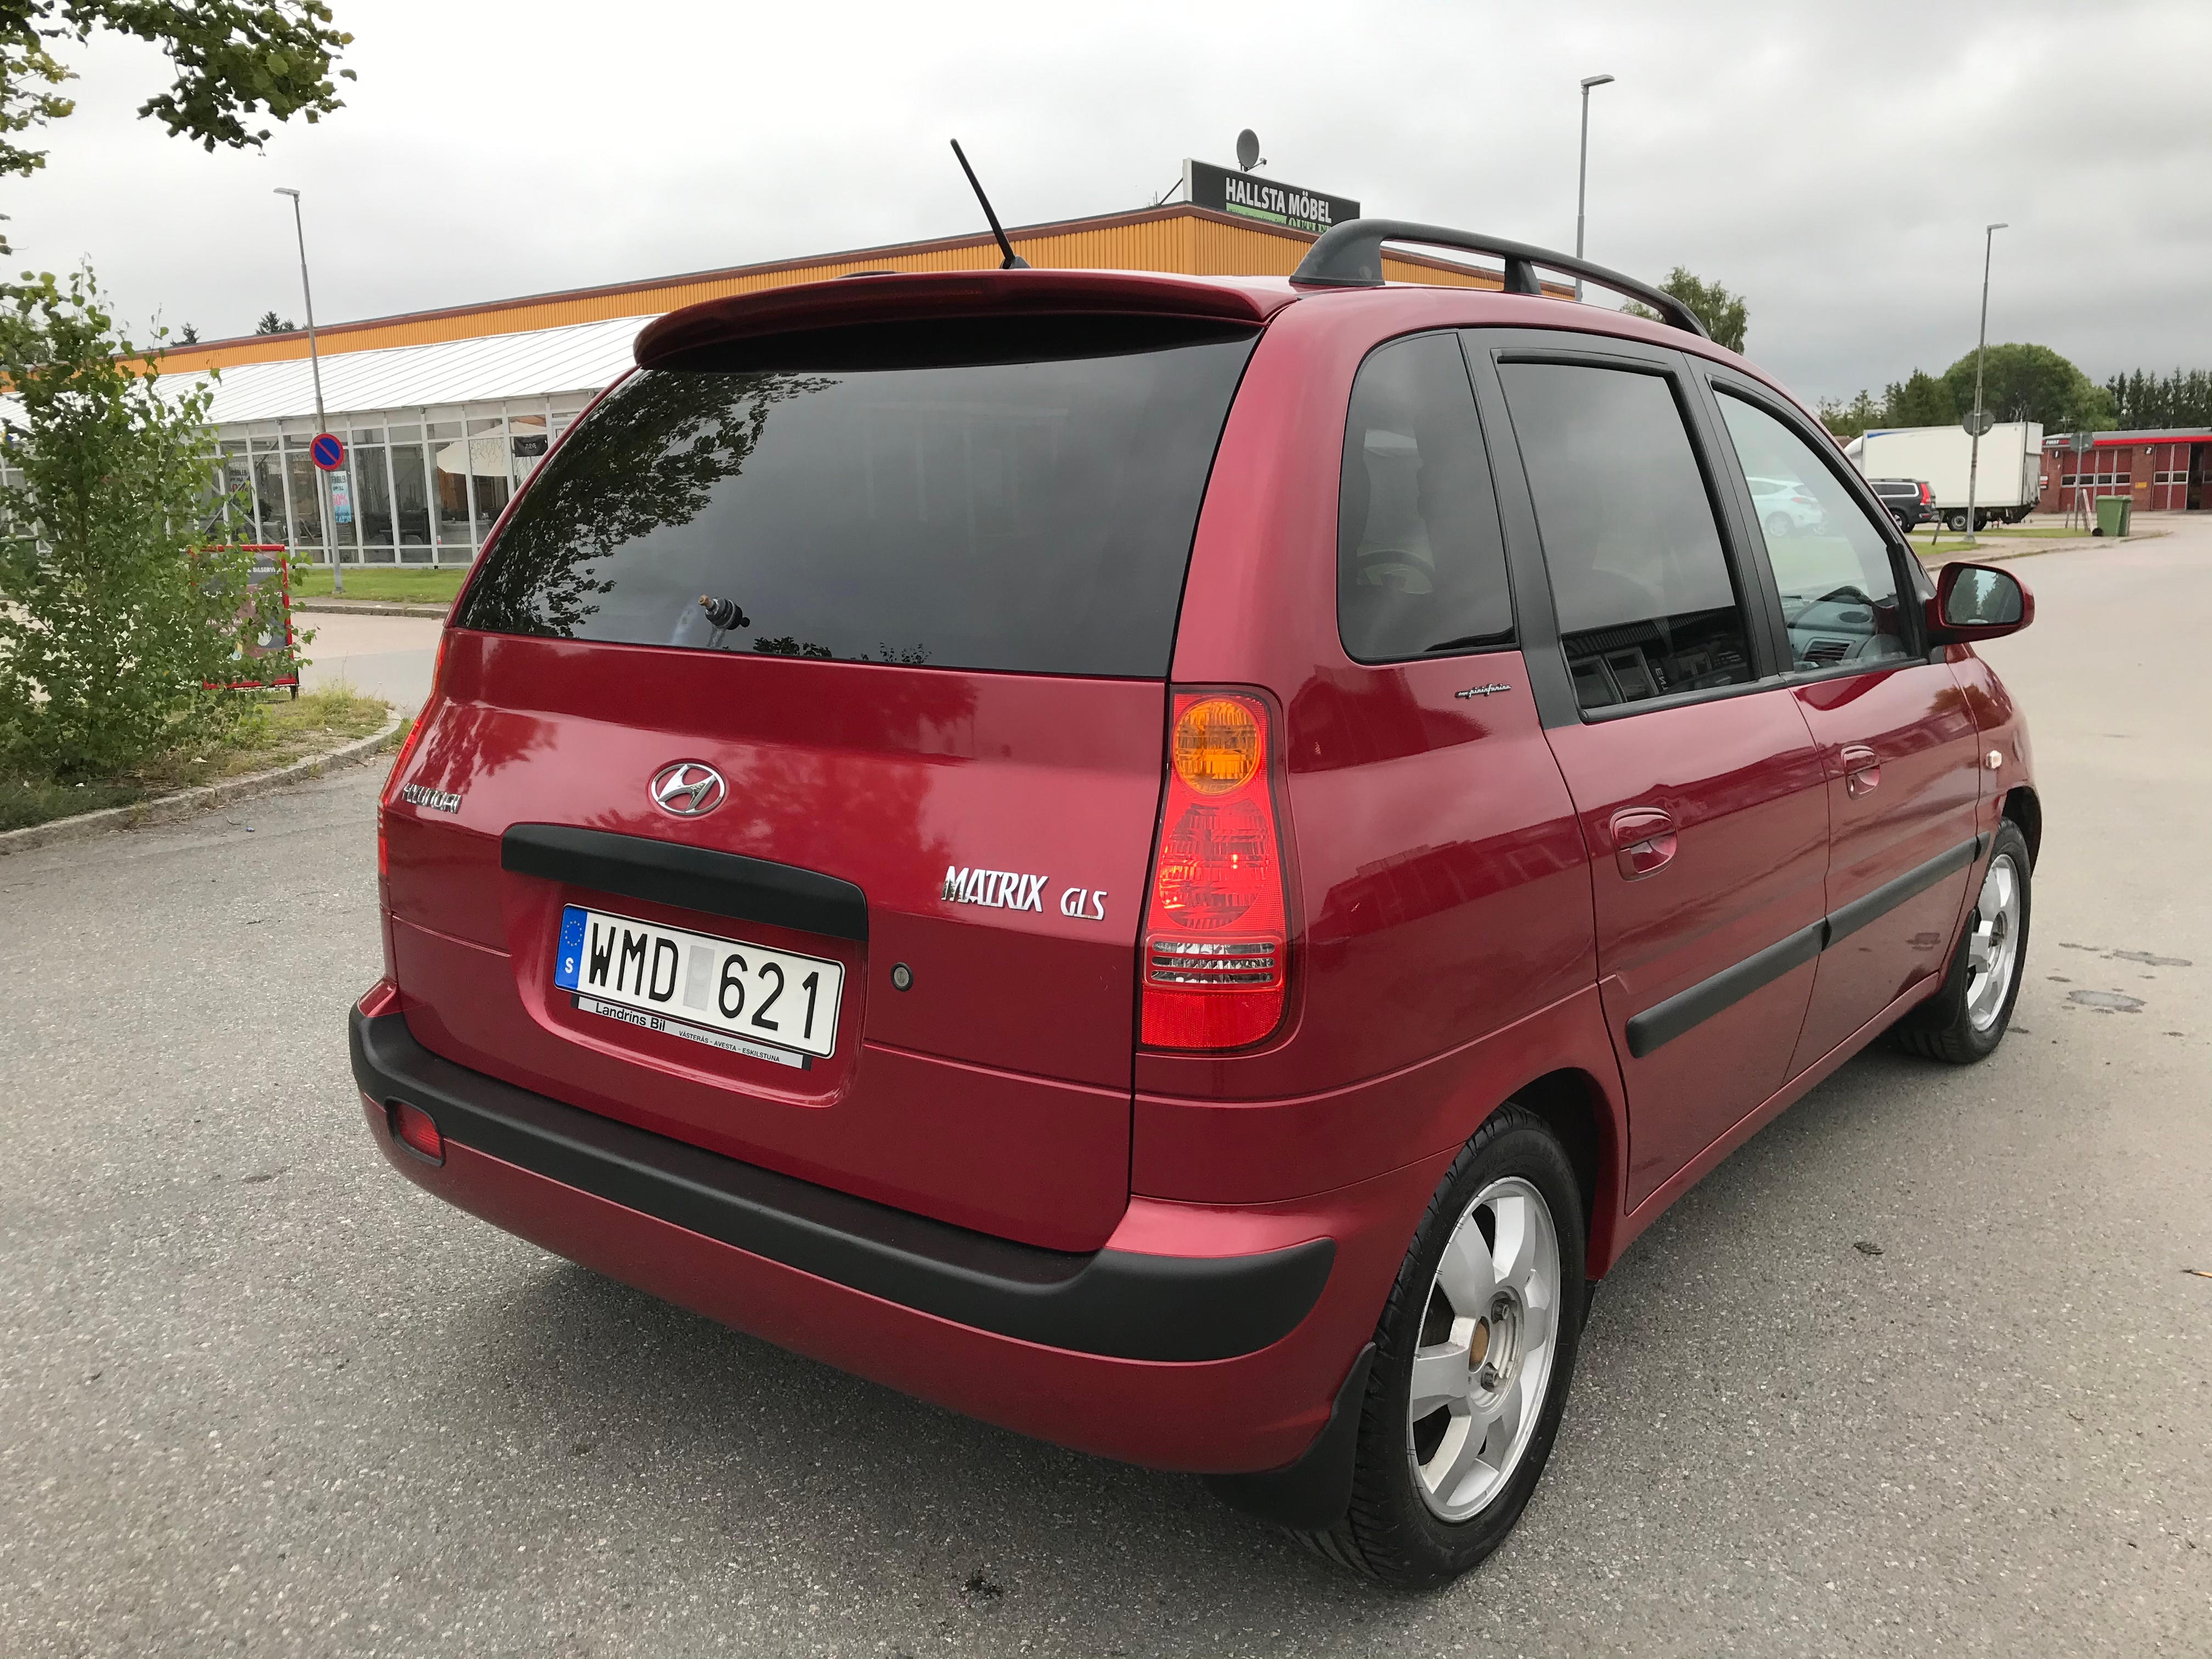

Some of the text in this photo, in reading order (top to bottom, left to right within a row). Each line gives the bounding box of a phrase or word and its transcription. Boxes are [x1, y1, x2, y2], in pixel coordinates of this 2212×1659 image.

[1226, 177, 1286, 213] HALLSTA
[1289, 190, 1332, 224] MÖBEL
[940, 865, 1108, 921] MATRIX GLS
[564, 957, 574, 974] S
[589, 922, 819, 1040] WMD 621
[595, 1002, 666, 1031] Landrins Bil
[679, 1030, 709, 1043] VÄSTERÅS
[714, 1040, 737, 1051] AVESTA
[742, 1048, 780, 1062] ESKILSTUNA
